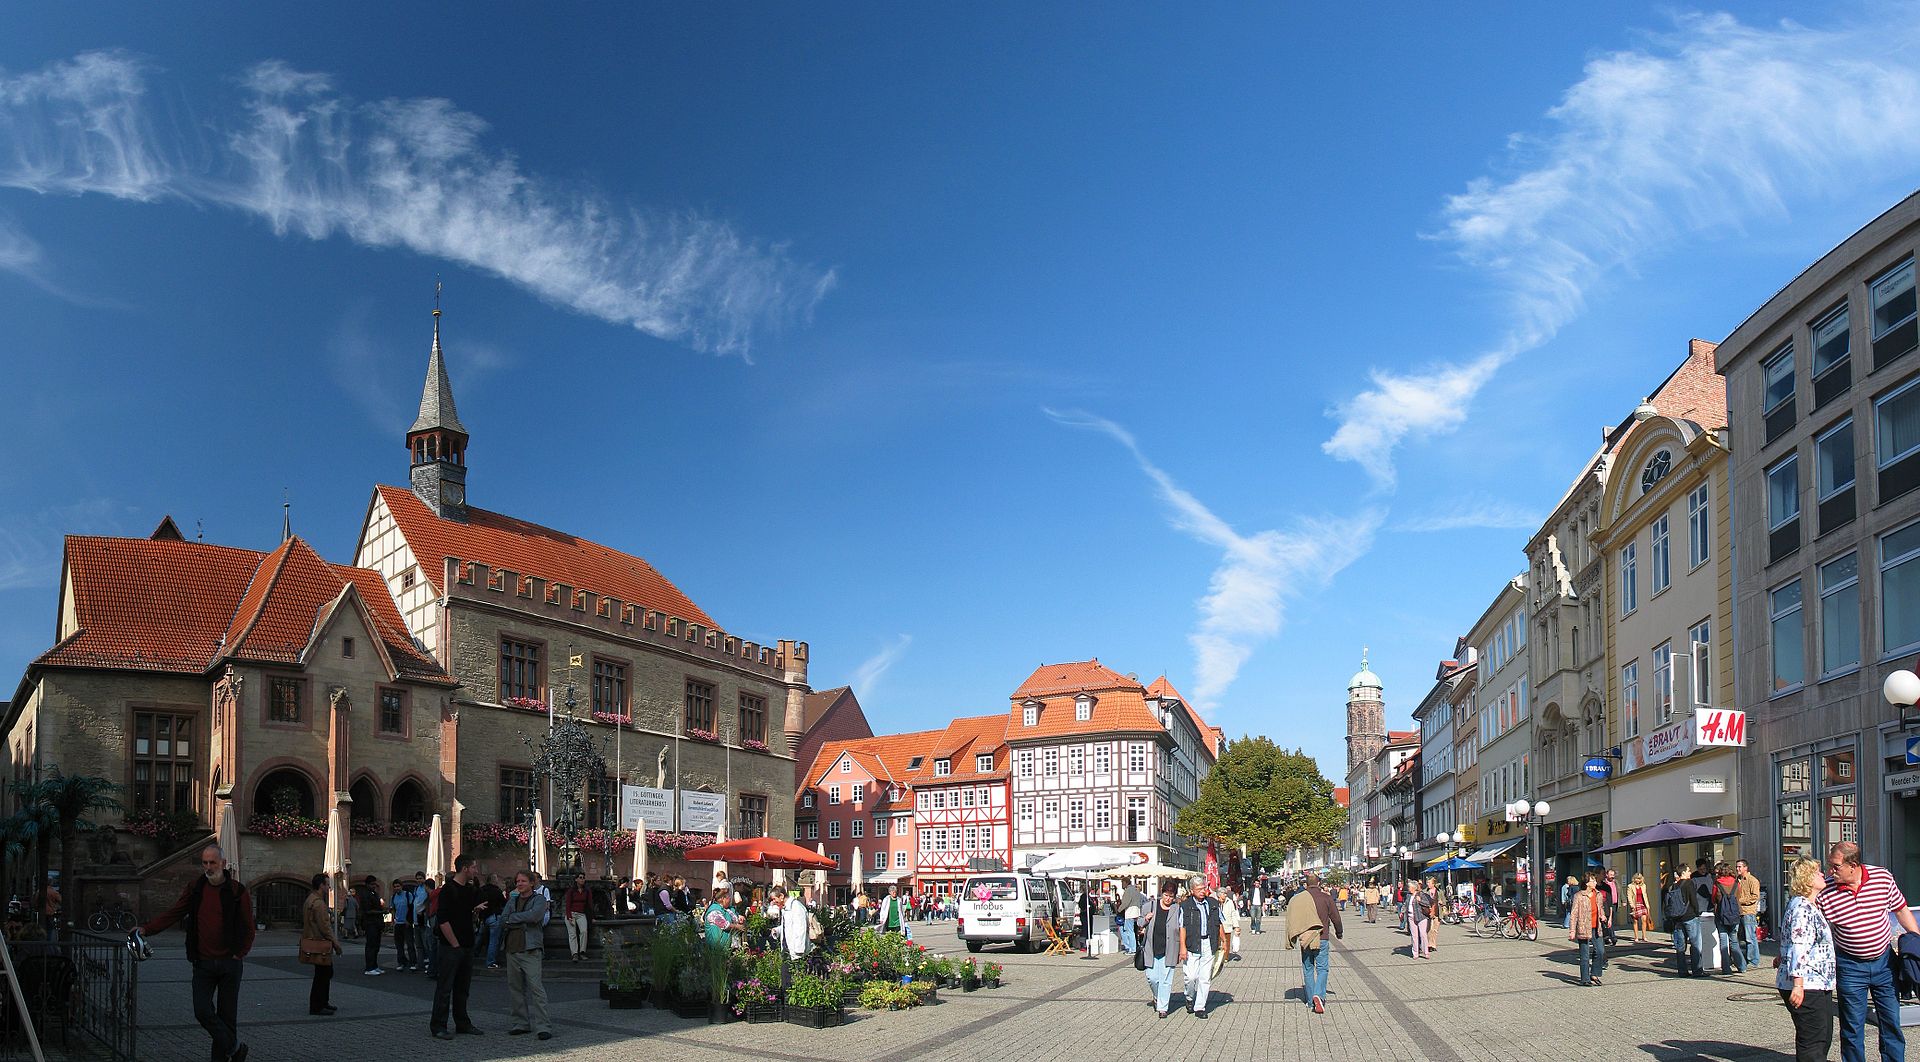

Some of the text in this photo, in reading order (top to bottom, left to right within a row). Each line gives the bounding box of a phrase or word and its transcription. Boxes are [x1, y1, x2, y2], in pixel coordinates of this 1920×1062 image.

[1653, 725, 1681, 748] BRAUT
[1701, 711, 1745, 745] H&M
[973, 902, 1004, 911] InfoBus
